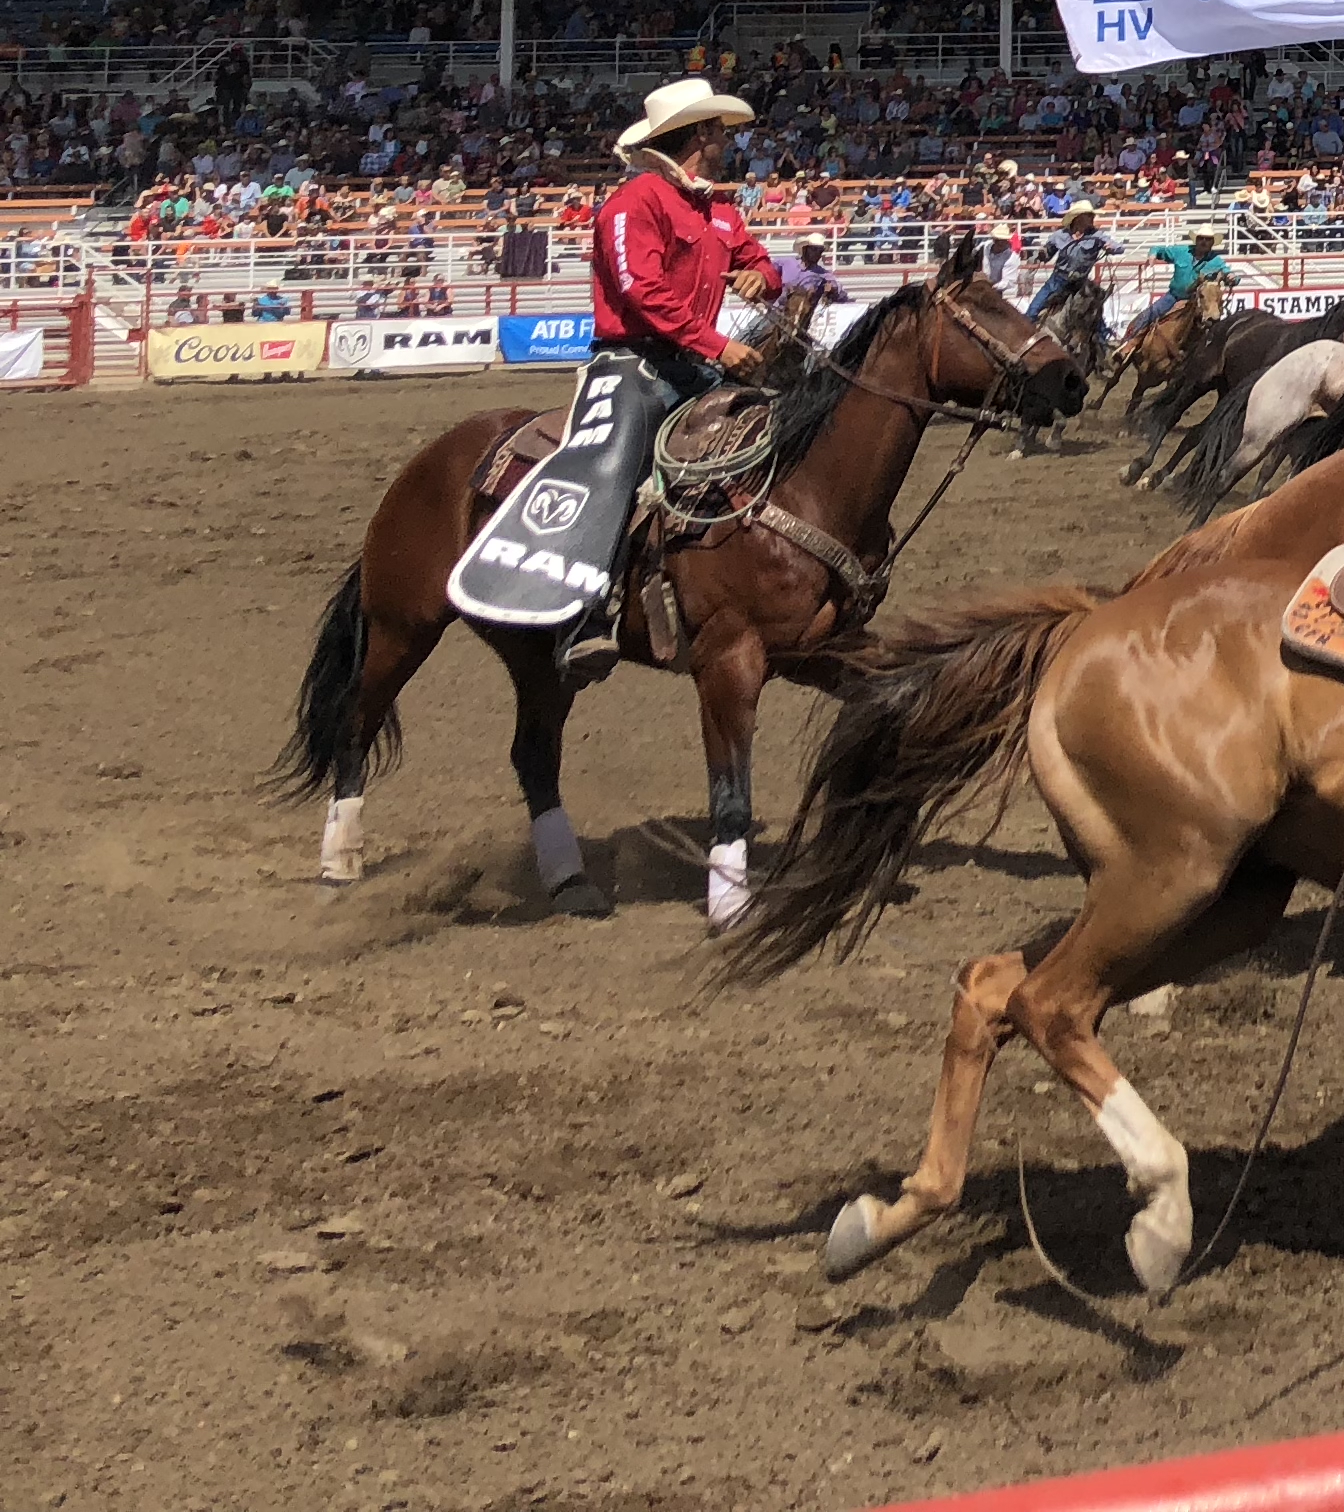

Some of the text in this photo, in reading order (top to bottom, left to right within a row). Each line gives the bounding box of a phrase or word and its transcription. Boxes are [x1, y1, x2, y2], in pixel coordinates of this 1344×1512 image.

[1097, 7, 1153, 43] HV
[383, 328, 492, 350] RAM
[530, 319, 576, 340] ATB
[174, 335, 256, 363] Coors
[569, 374, 623, 448] RAM
[479, 537, 611, 599] RAM
